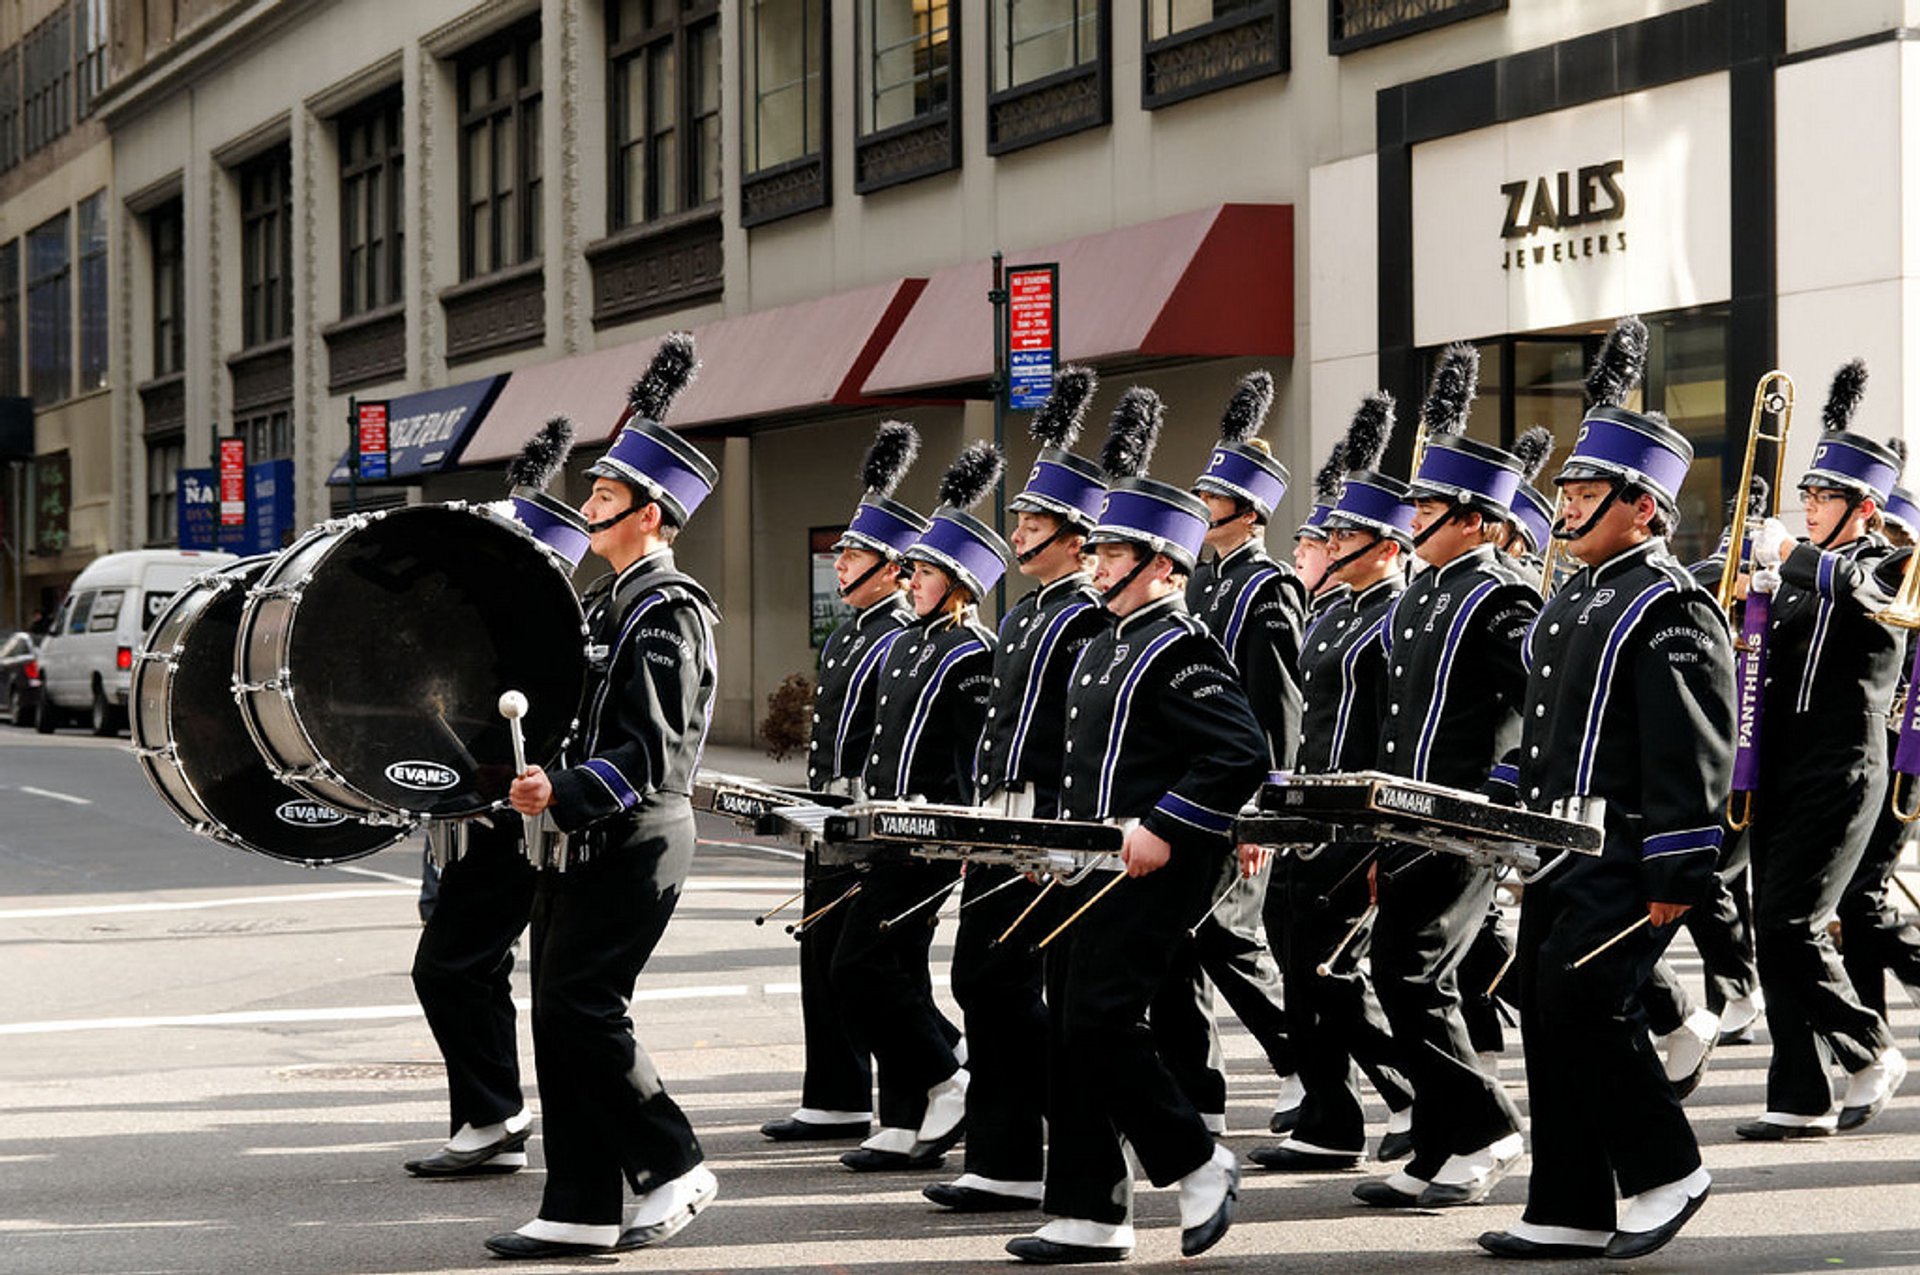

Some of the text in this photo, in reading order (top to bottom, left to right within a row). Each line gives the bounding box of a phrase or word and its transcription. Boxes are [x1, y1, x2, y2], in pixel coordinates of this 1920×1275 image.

[1500, 159, 1626, 239] ZALES
[1501, 232, 1626, 270] JEWELERS
[1738, 633, 1762, 748] PANTHERS
[393, 767, 449, 784] EVANS
[284, 805, 339, 820] EVANS
[1379, 787, 1434, 817] YAMAHA
[880, 814, 937, 836] YAMAHA
